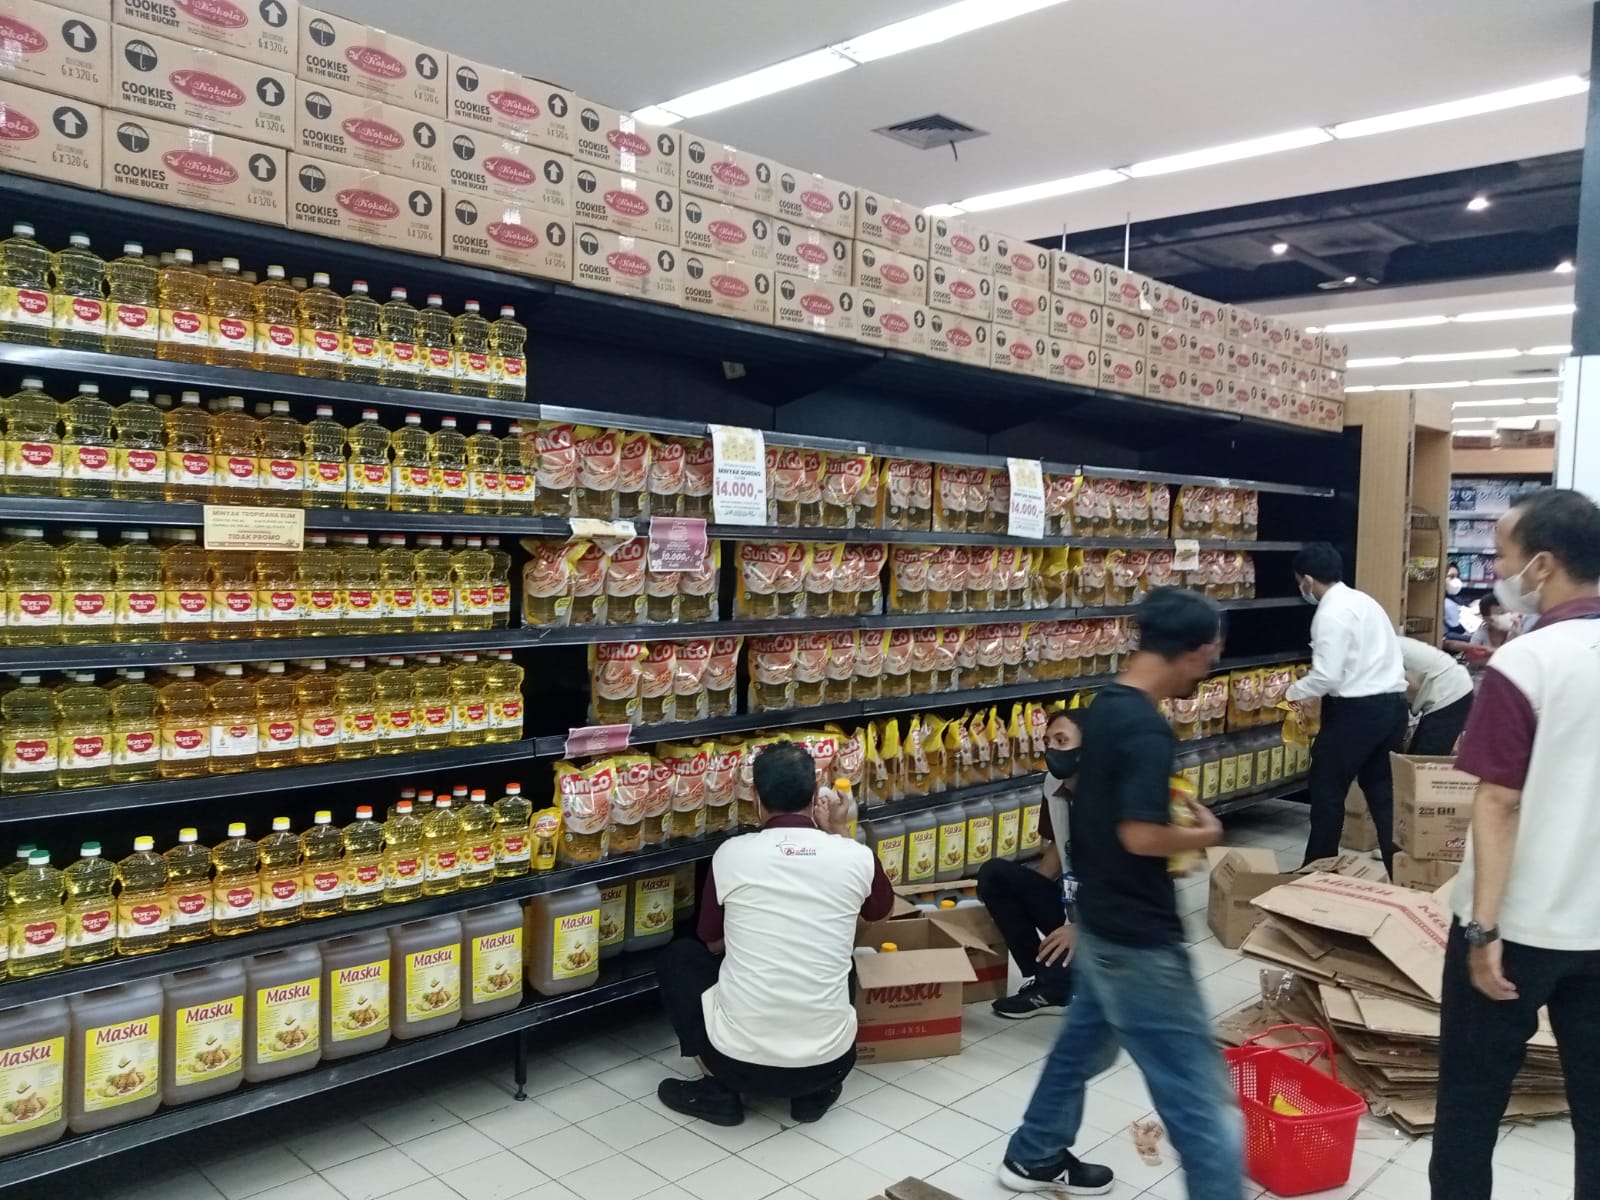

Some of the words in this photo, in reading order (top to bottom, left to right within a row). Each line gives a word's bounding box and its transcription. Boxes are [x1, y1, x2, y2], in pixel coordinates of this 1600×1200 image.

[306, 54, 348, 73] COOKIES
[122, 81, 173, 102] COOKIES
[454, 100, 490, 115] COOKIES
[302, 129, 344, 146] COOKIES
[578, 139, 608, 153] COOKIES
[114, 163, 166, 181] COOKIES
[450, 168, 486, 184] COOKIES
[296, 202, 338, 218] COOKIES
[576, 201, 606, 214] COOKIES
[452, 234, 488, 248] COOKIES
[580, 264, 609, 276] COOKIES
[640, 878, 670, 892] Masku
[601, 888, 622, 902] asku
[560, 914, 593, 930] Masku
[479, 932, 516, 950] Masku
[413, 949, 452, 968] Masku
[339, 964, 382, 984] Masku
[266, 984, 311, 1004] Masku
[186, 1001, 233, 1024] Masku
[96, 1020, 148, 1045] Masku
